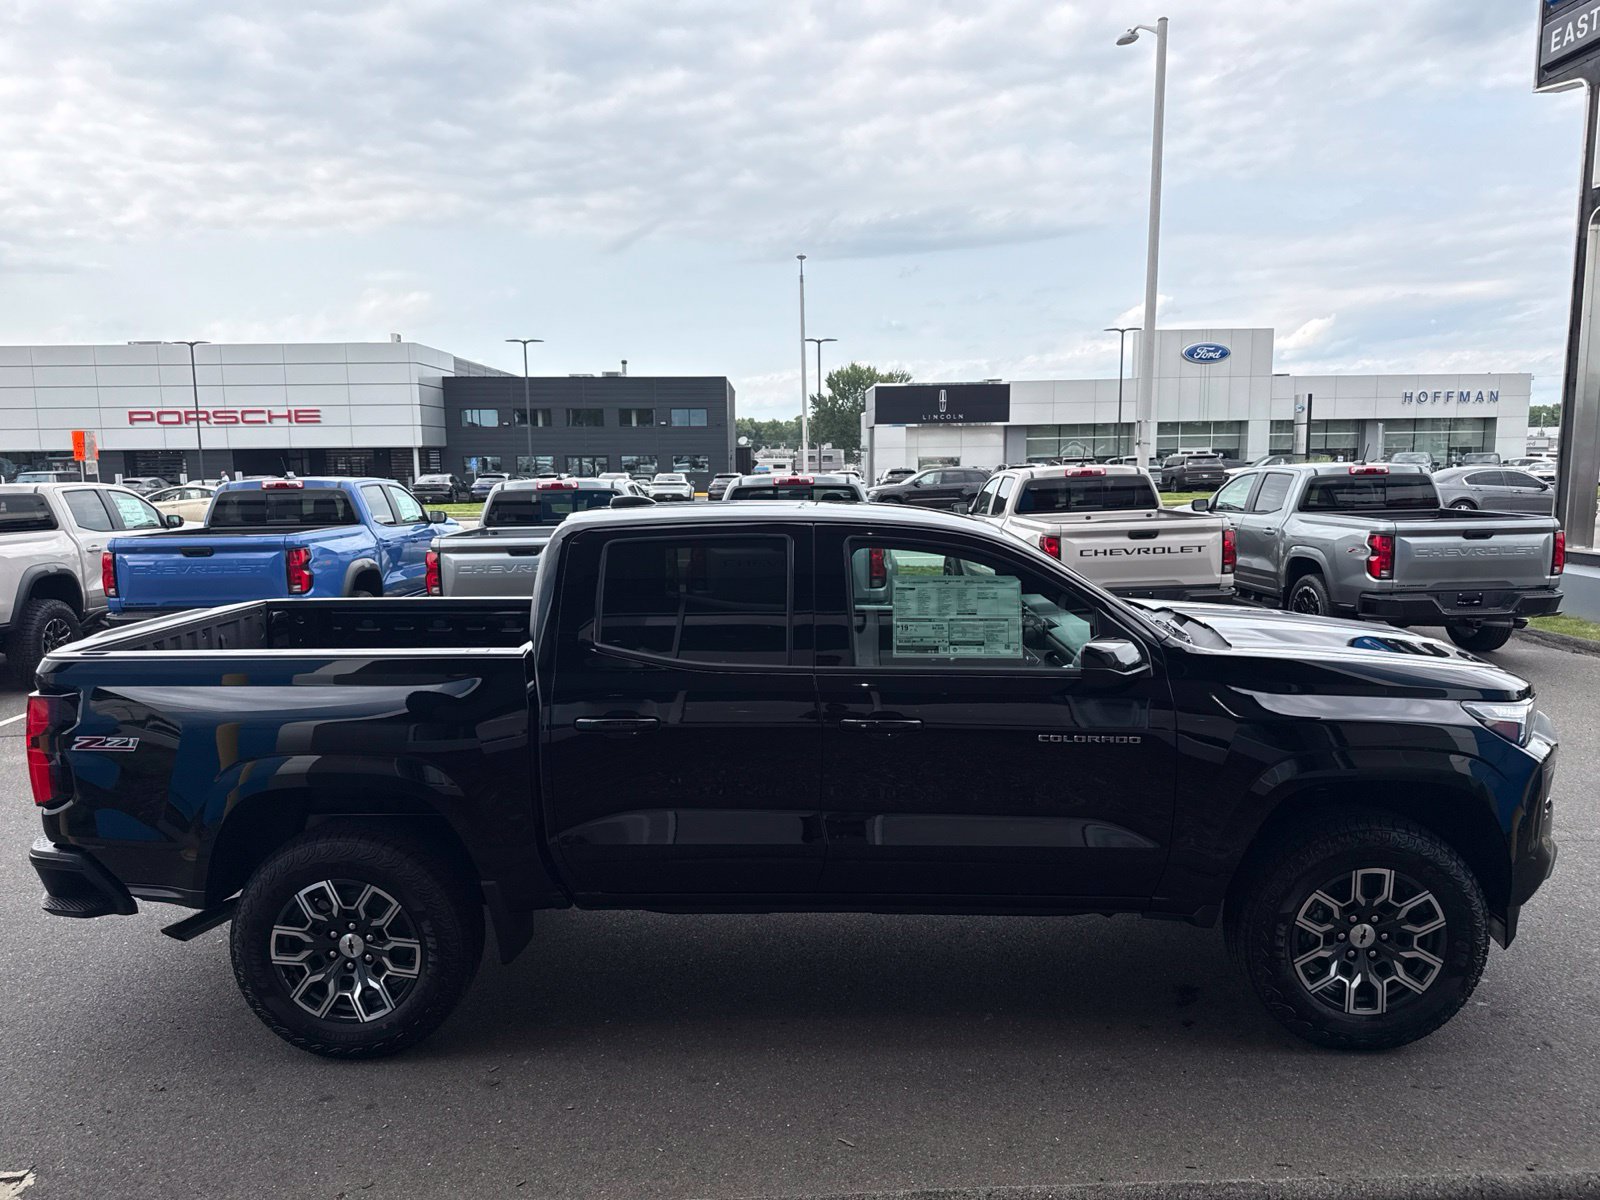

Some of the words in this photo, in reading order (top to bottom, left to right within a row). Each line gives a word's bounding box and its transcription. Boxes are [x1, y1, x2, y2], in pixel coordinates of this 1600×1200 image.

[1550, 5, 1600, 53] EAST
[1193, 346, 1222, 359] Ford
[1403, 390, 1499, 403] HOFFMAN
[128, 409, 321, 425] PORSCHE
[1080, 545, 1206, 557] CHEVROLET
[1414, 546, 1540, 558] CHEVROLET
[458, 564, 540, 574] CHEVR
[71, 736, 140, 751] Z71
[1038, 734, 1142, 743] COLORADO
